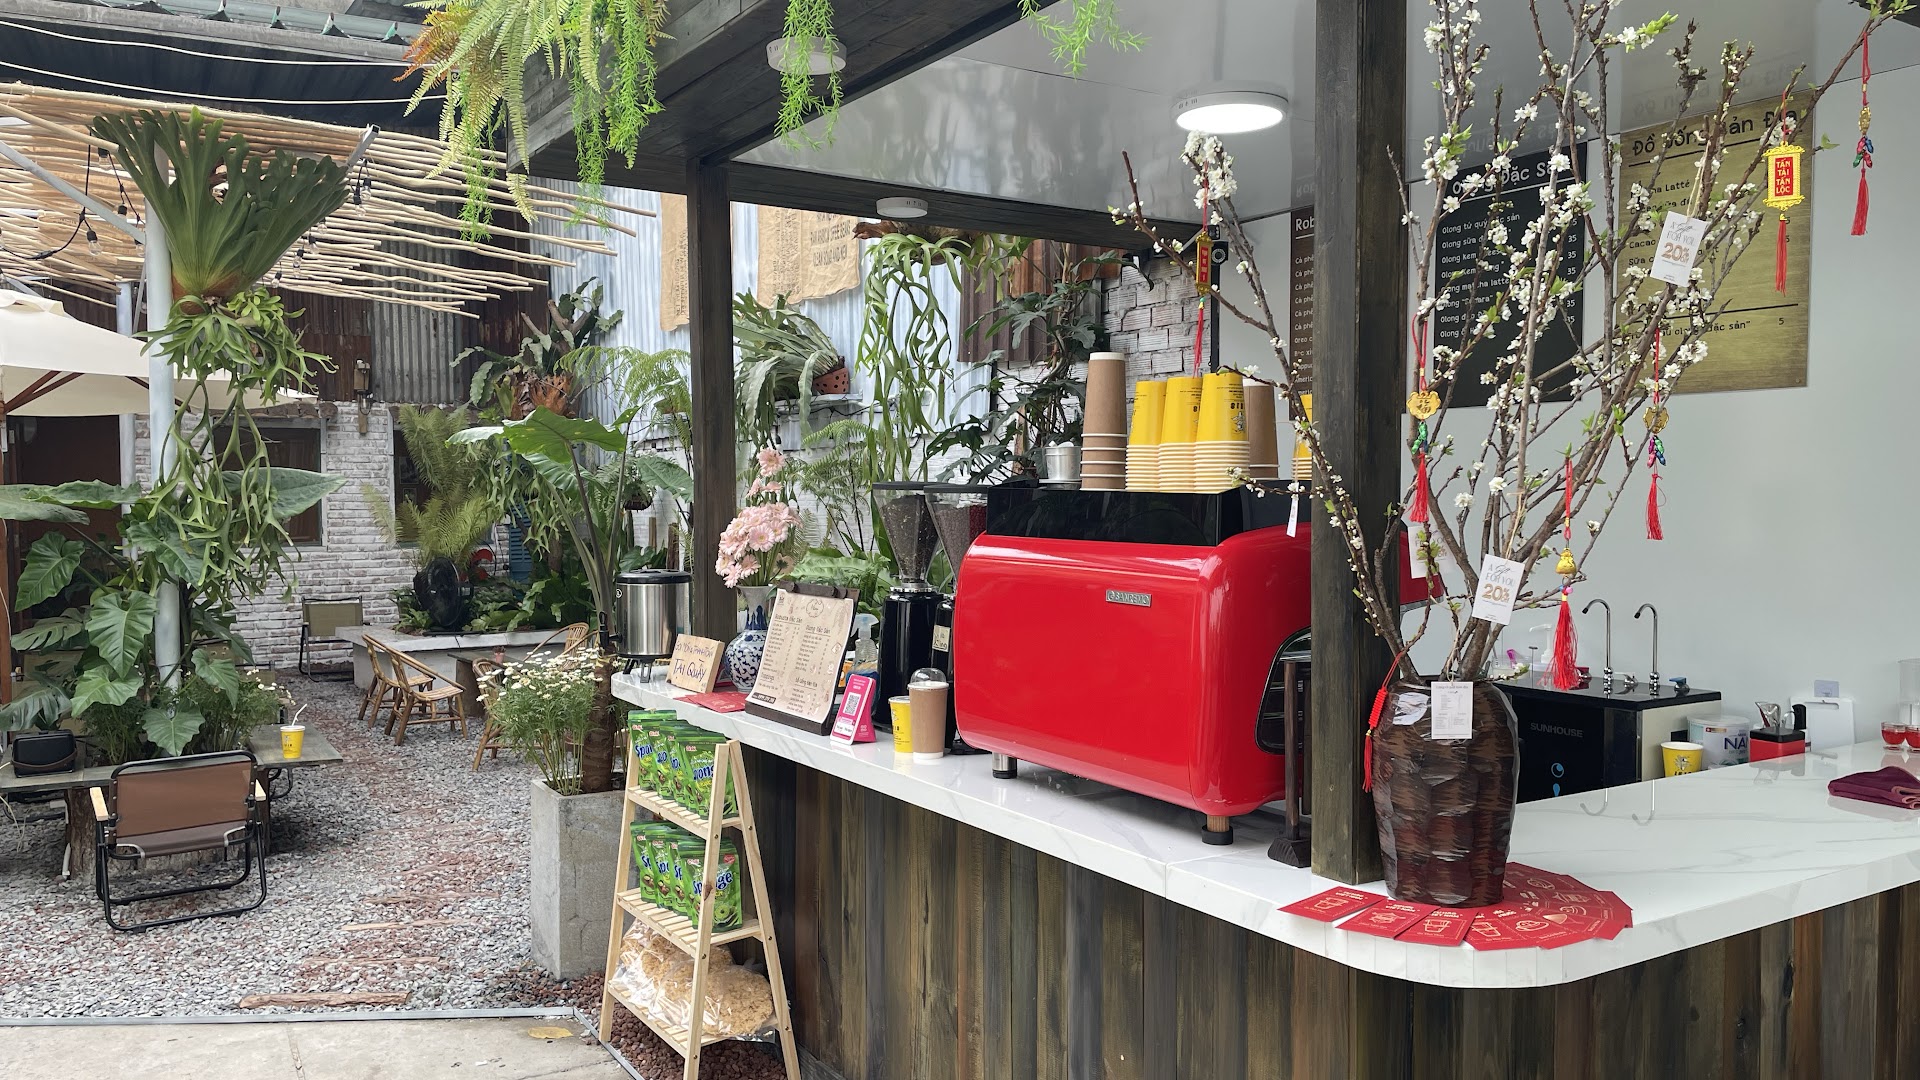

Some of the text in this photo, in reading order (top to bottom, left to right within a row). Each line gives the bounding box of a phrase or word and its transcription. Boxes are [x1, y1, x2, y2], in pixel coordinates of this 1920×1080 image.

[1728, 116, 1754, 135] ản
[1776, 185, 1791, 195] LỘC
[1442, 224, 1461, 234] Olong
[1442, 239, 1461, 249] Olong
[1568, 235, 1577, 243] 35
[1441, 254, 1461, 264] Olong
[1462, 250, 1477, 260] kem
[1567, 251, 1576, 259] 35
[1567, 267, 1576, 275] 35
[1440, 314, 1460, 323] Olong
[1440, 330, 1459, 338] Olong
[673, 658, 685, 679] TẠI
[1530, 722, 1583, 738] SUNHOUSE
[1724, 737, 1748, 750] NA
